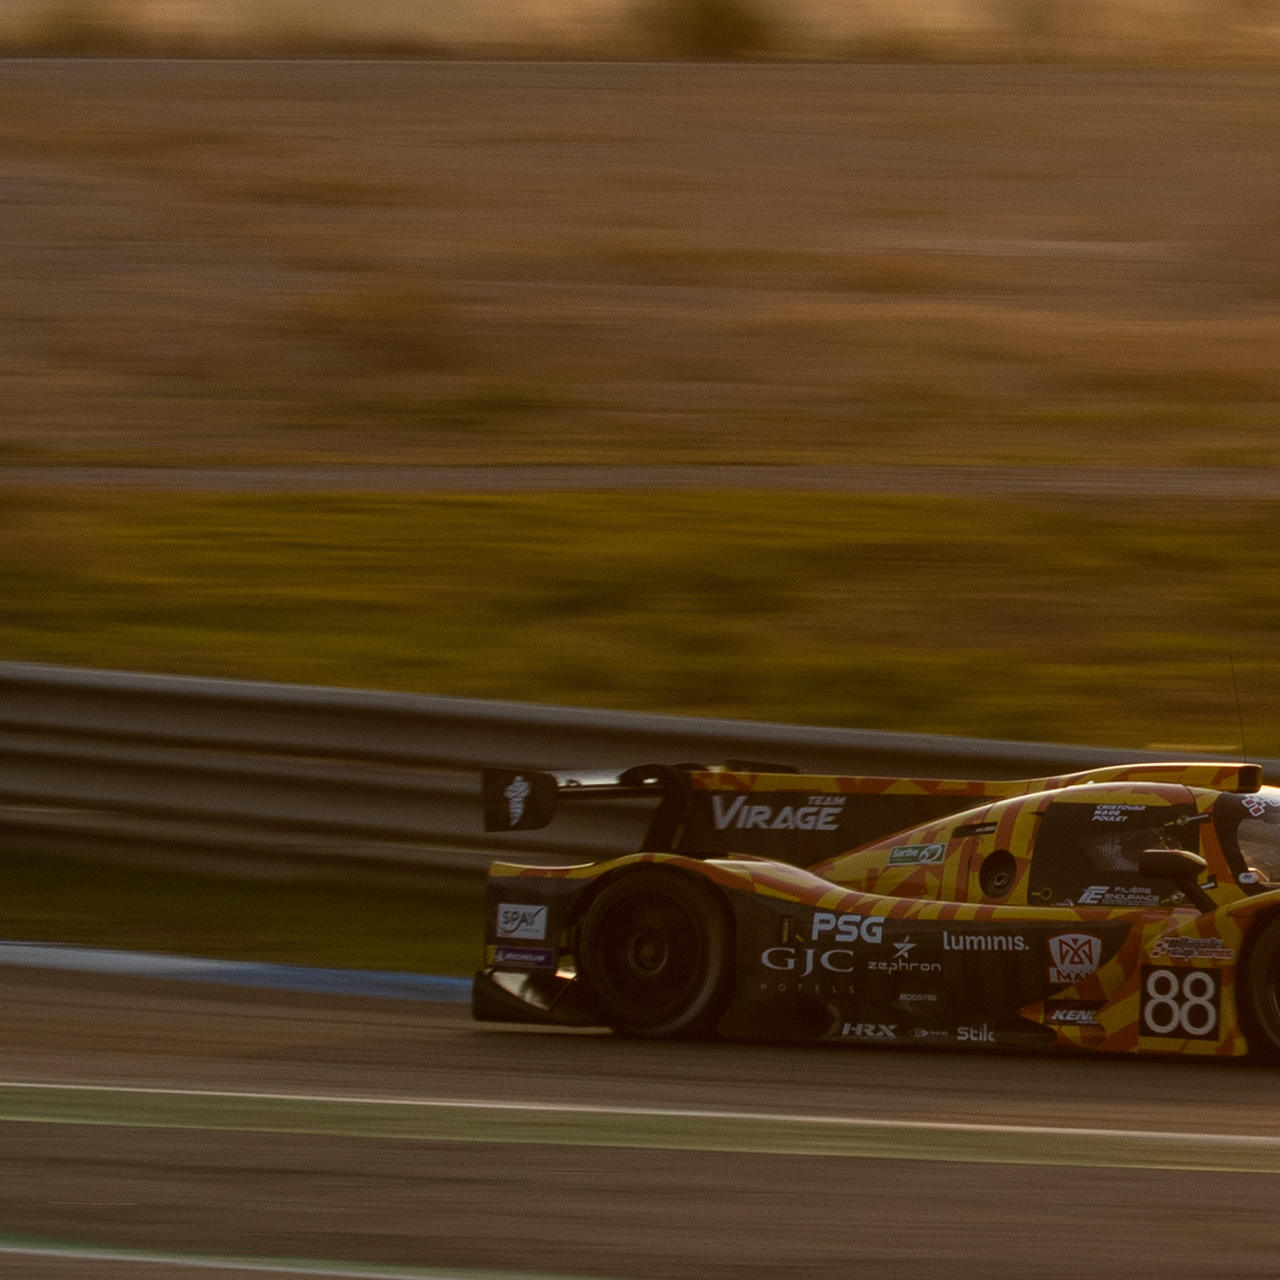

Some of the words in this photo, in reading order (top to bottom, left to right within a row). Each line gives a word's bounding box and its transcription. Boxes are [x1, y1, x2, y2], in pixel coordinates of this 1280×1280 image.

[807, 795, 847, 806] TEAM
[711, 795, 845, 831] VIRAGE
[1104, 893, 1160, 902] ENDURANCE
[811, 912, 886, 944] PSG
[942, 931, 1030, 951] luminis.
[760, 947, 855, 978] GJC
[867, 958, 942, 975] zephron
[1144, 969, 1217, 1036] 88
[841, 1022, 899, 1037] HRX
